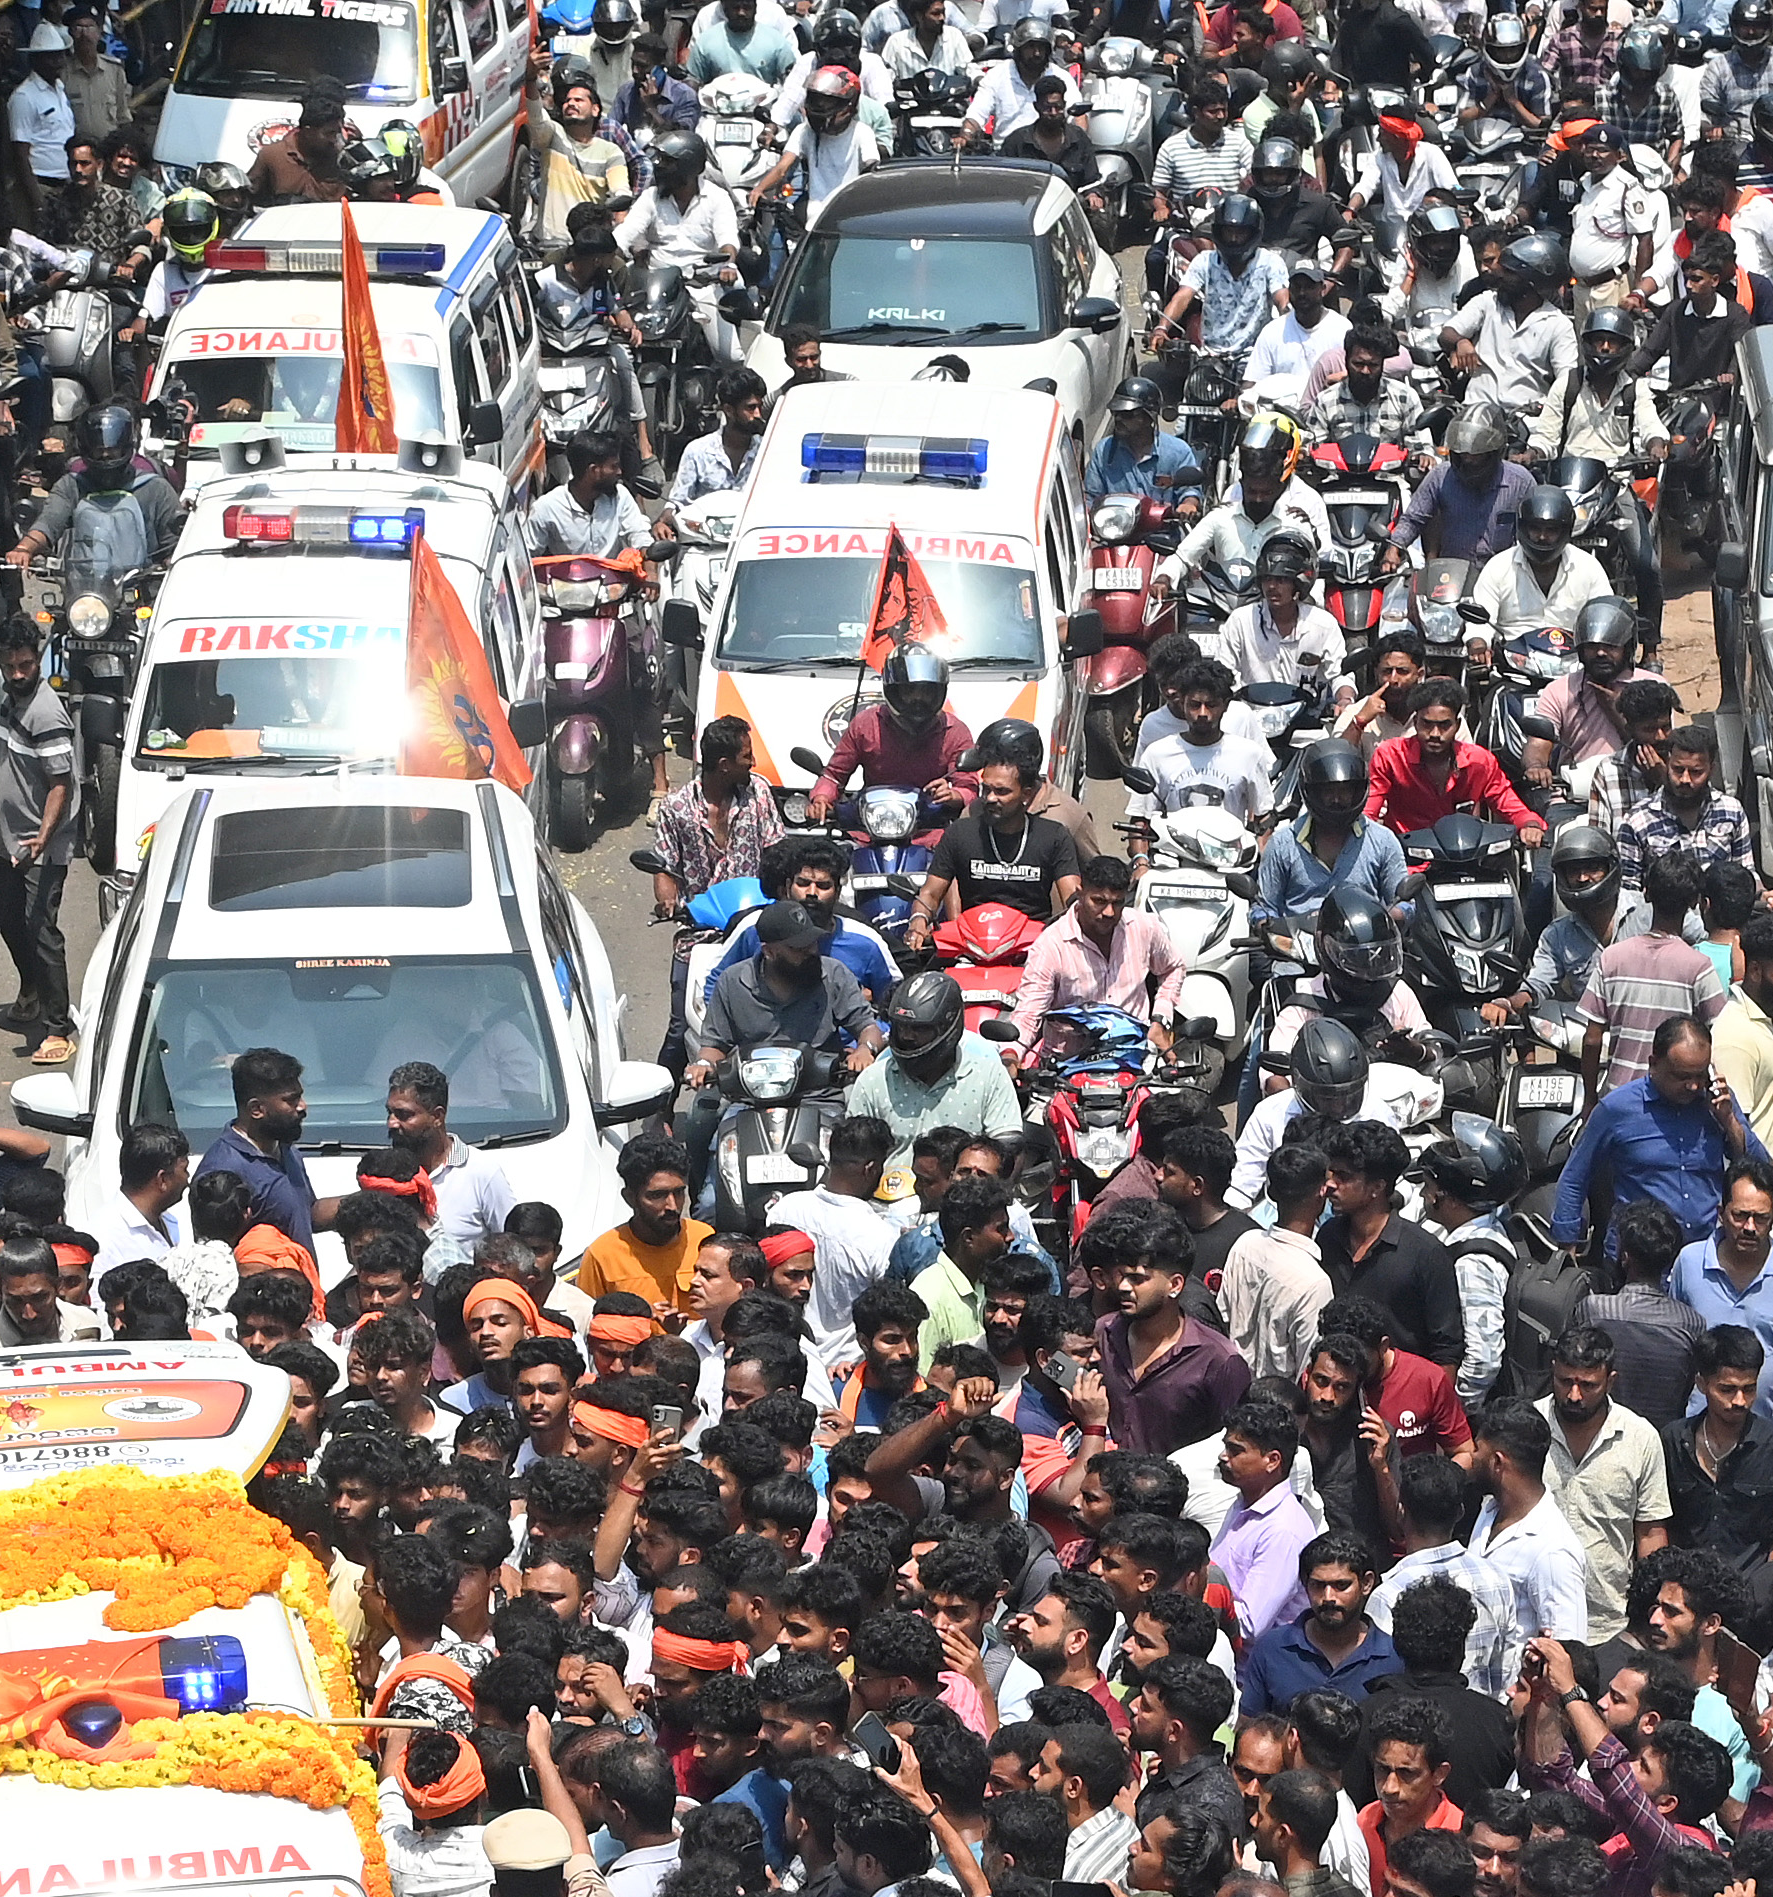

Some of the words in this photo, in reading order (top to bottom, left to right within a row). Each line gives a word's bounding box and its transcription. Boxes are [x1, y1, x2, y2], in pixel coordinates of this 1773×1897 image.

[322, 0, 409, 28] TIGERS
[295, 960, 335, 969] SHREE
[336, 958, 391, 968] KARINJA
